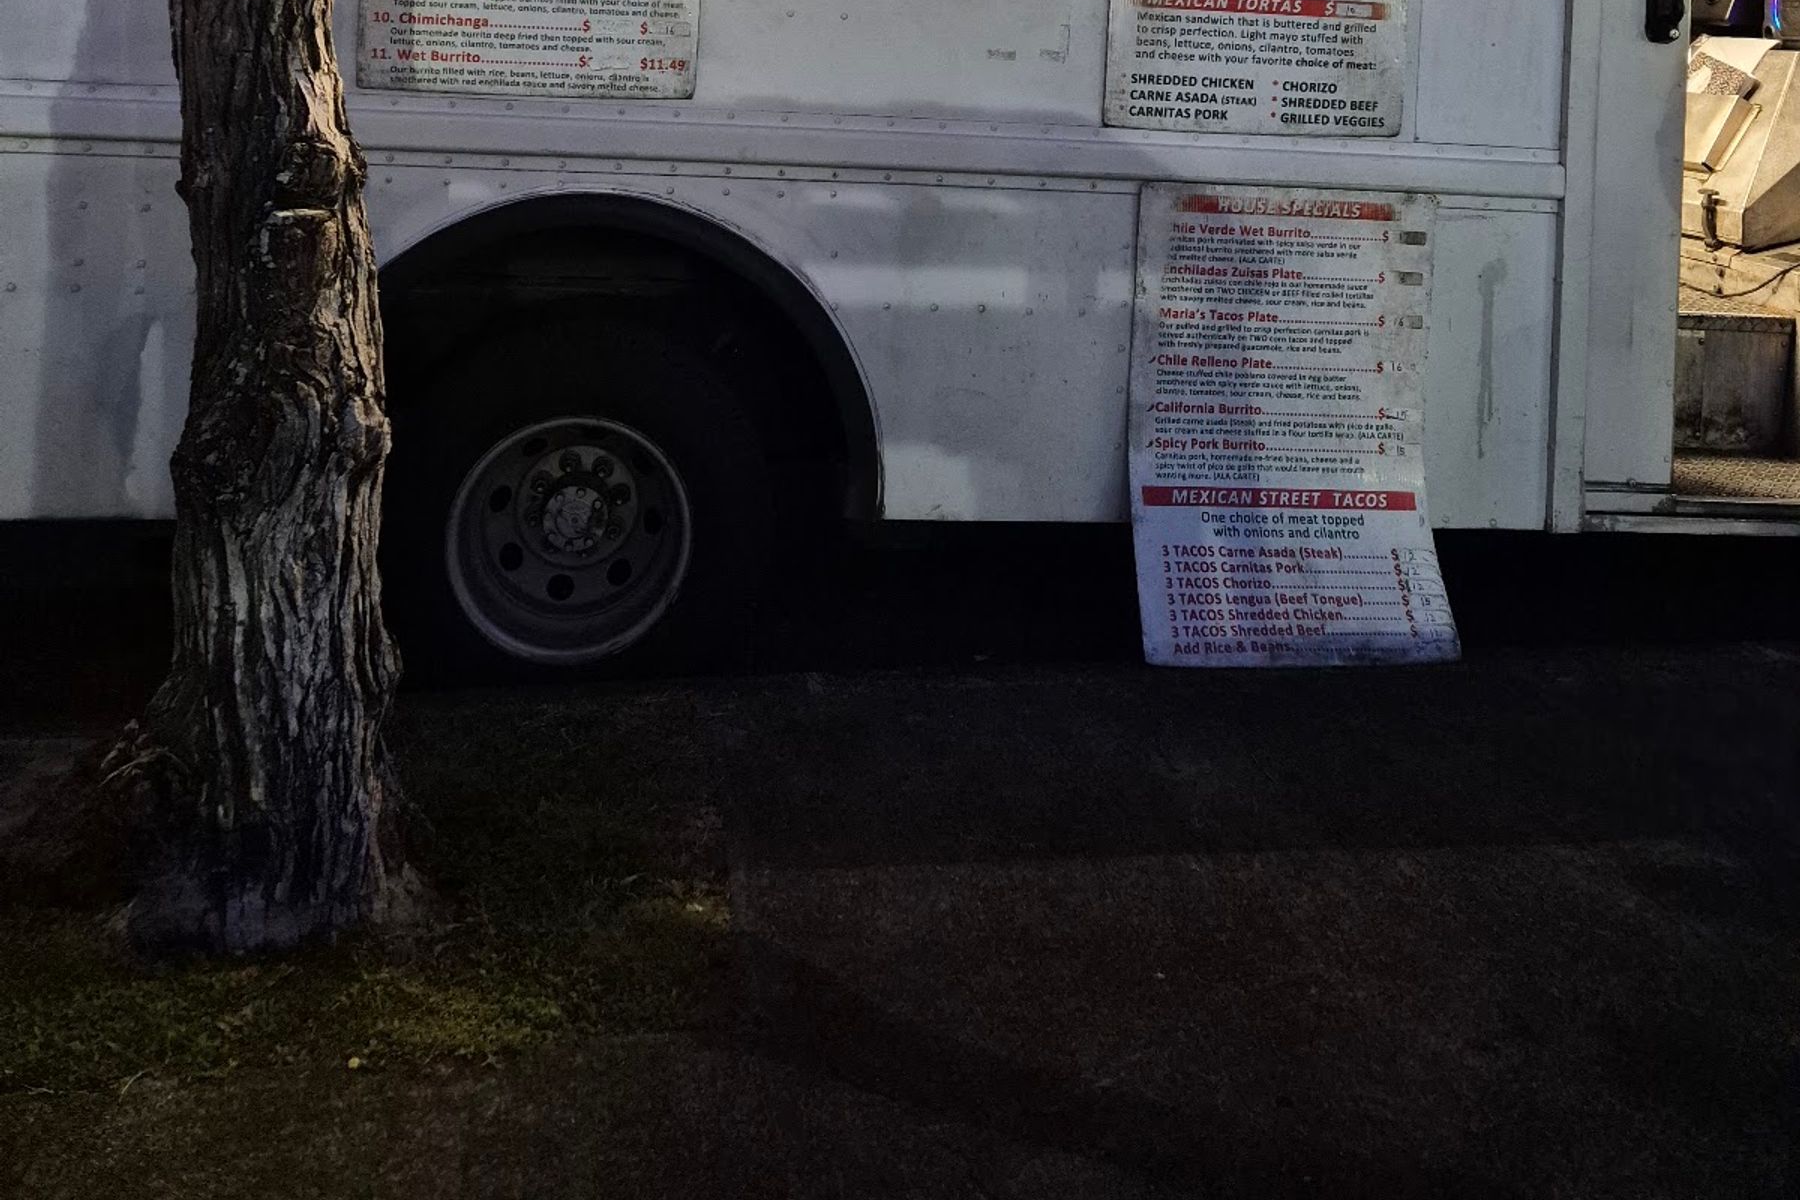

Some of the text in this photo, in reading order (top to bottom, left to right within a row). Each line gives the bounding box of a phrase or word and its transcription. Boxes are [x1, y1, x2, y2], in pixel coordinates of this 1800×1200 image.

[601, 0, 619, 10] your
[622, 0, 648, 9] choice
[650, 0, 660, 9] of
[374, 10, 489, 30] 10. Chimichanga
[1136, 11, 1376, 34] Mexican sandwich that is buttered and grilled
[1136, 24, 1363, 44] to crisp perfection. Light mayo stuffed with
[1135, 36, 1354, 56] beans, lettuce, onions, cilantro, tomatoes
[370, 47, 480, 64] 11. Wet Burrito
[1135, 49, 1155, 59] and
[1157, 50, 1195, 61] cheese
[1198, 52, 1221, 62] with
[1224, 55, 1248, 66] your
[1251, 54, 1292, 66] favorite
[1295, 57, 1329, 68] choice
[1331, 58, 1343, 68] of
[639, 57, 685, 72] $11.49
[1130, 73, 1254, 89] SHREDDED CHICKEN
[1281, 80, 1337, 94] CHORIZO
[1129, 89, 1257, 106] CARNE ASADA (STEAK)
[1280, 96, 1378, 111] SHREDDED BEEF
[1128, 105, 1228, 121] CARNITAS PORK
[1280, 112, 1384, 128] GRILLED VEGGIES
[1217, 199, 1361, 218] HOUSE SPECIALS
[1167, 222, 1311, 239] hile Verde Wet Burrito
[1164, 264, 1303, 280] Enchiladas Zuisas Plate
[1210, 309, 1244, 321] Tacos
[1248, 311, 1279, 322] Plate
[1156, 353, 1273, 369] Chile Relleno Plate
[1154, 401, 1262, 416] California Burrito
[1154, 436, 1266, 452] Spicy Pork Burrito
[1172, 489, 1388, 507] MEXICAN STREET TACOS
[1201, 510, 1364, 527] One choice of meat topped
[1212, 525, 1360, 540] with onions and cilantro
[1162, 544, 1342, 562] 3 TACOS Carne Asada (Steak)
[1163, 560, 1305, 575] 3 TACOS Carnitas Pork
[1165, 576, 1272, 590] 3 TACOS Chorizo
[1167, 592, 1363, 609] 3 TACOS Lengua (Beef Tongue)
[1169, 608, 1344, 622] 3 TACOS Shredded Chicken
[1171, 624, 1327, 638] 3 TACOS Shredded Beef
